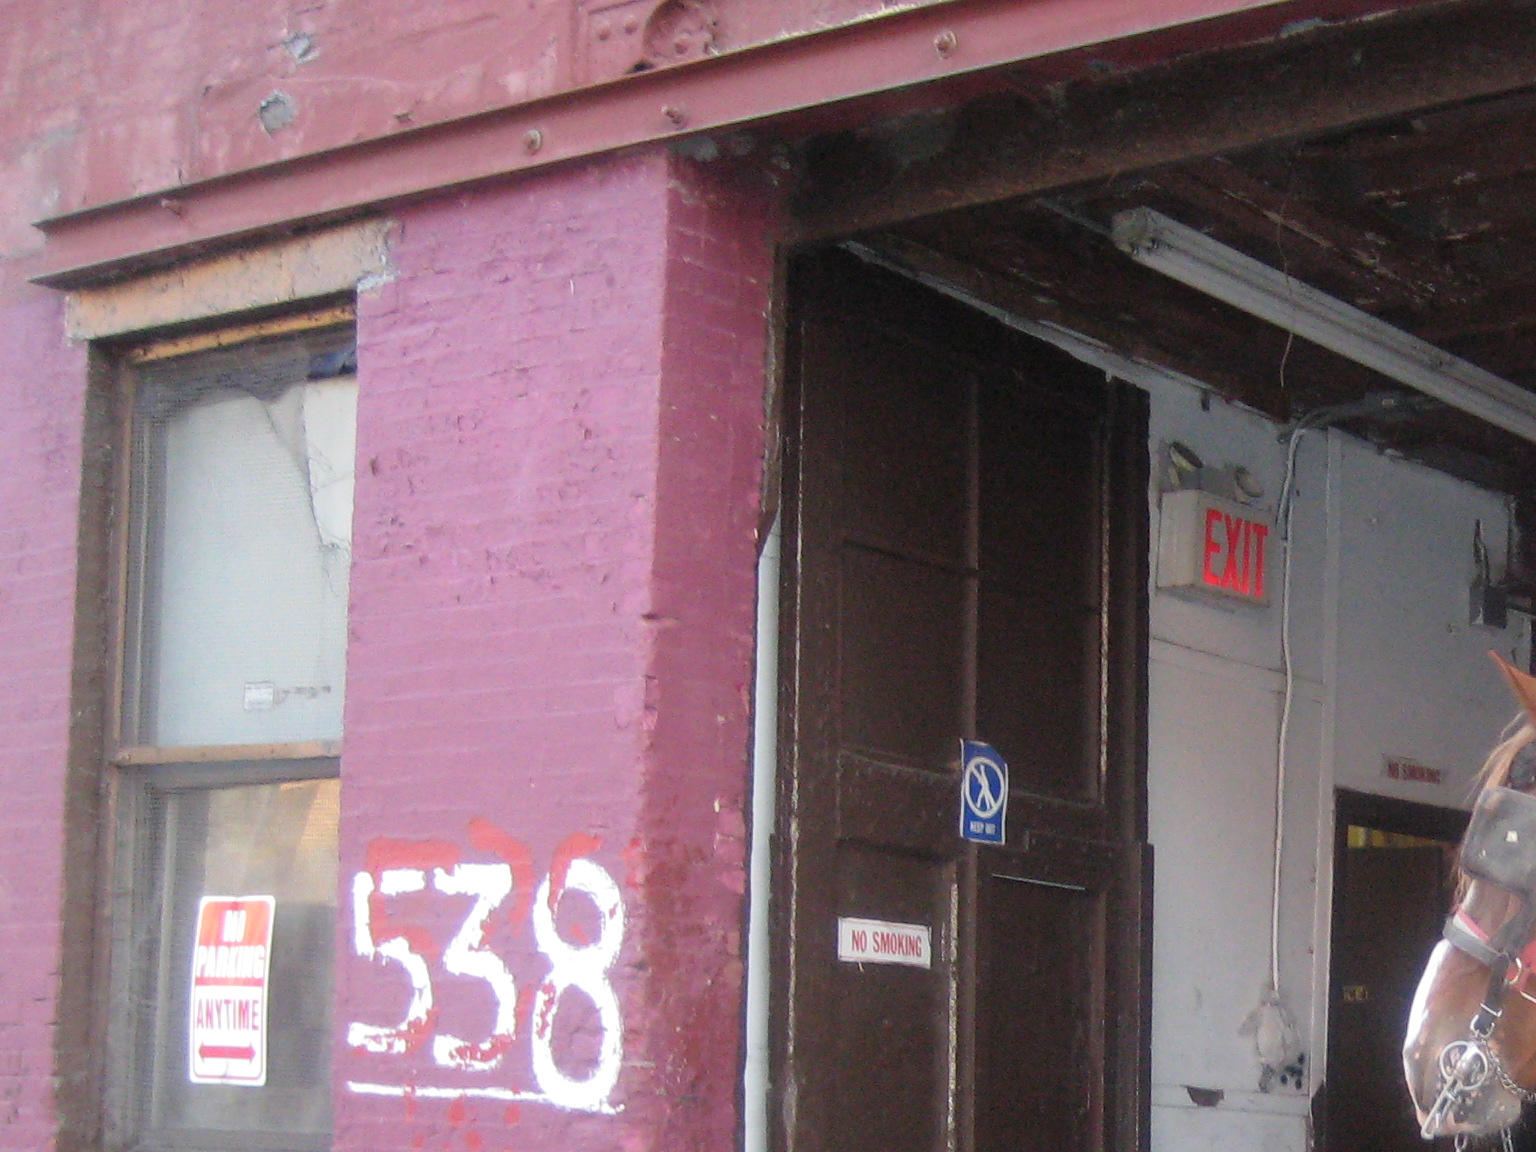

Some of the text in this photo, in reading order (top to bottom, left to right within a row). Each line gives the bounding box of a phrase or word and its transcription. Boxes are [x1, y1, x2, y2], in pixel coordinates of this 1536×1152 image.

[1203, 509, 1269, 597] EXIT
[223, 910, 246, 942] NO
[851, 930, 922, 957] NO SMOKING
[197, 945, 265, 979] PARKING
[347, 858, 625, 1110] 538
[197, 999, 259, 1030] ANYTIME
